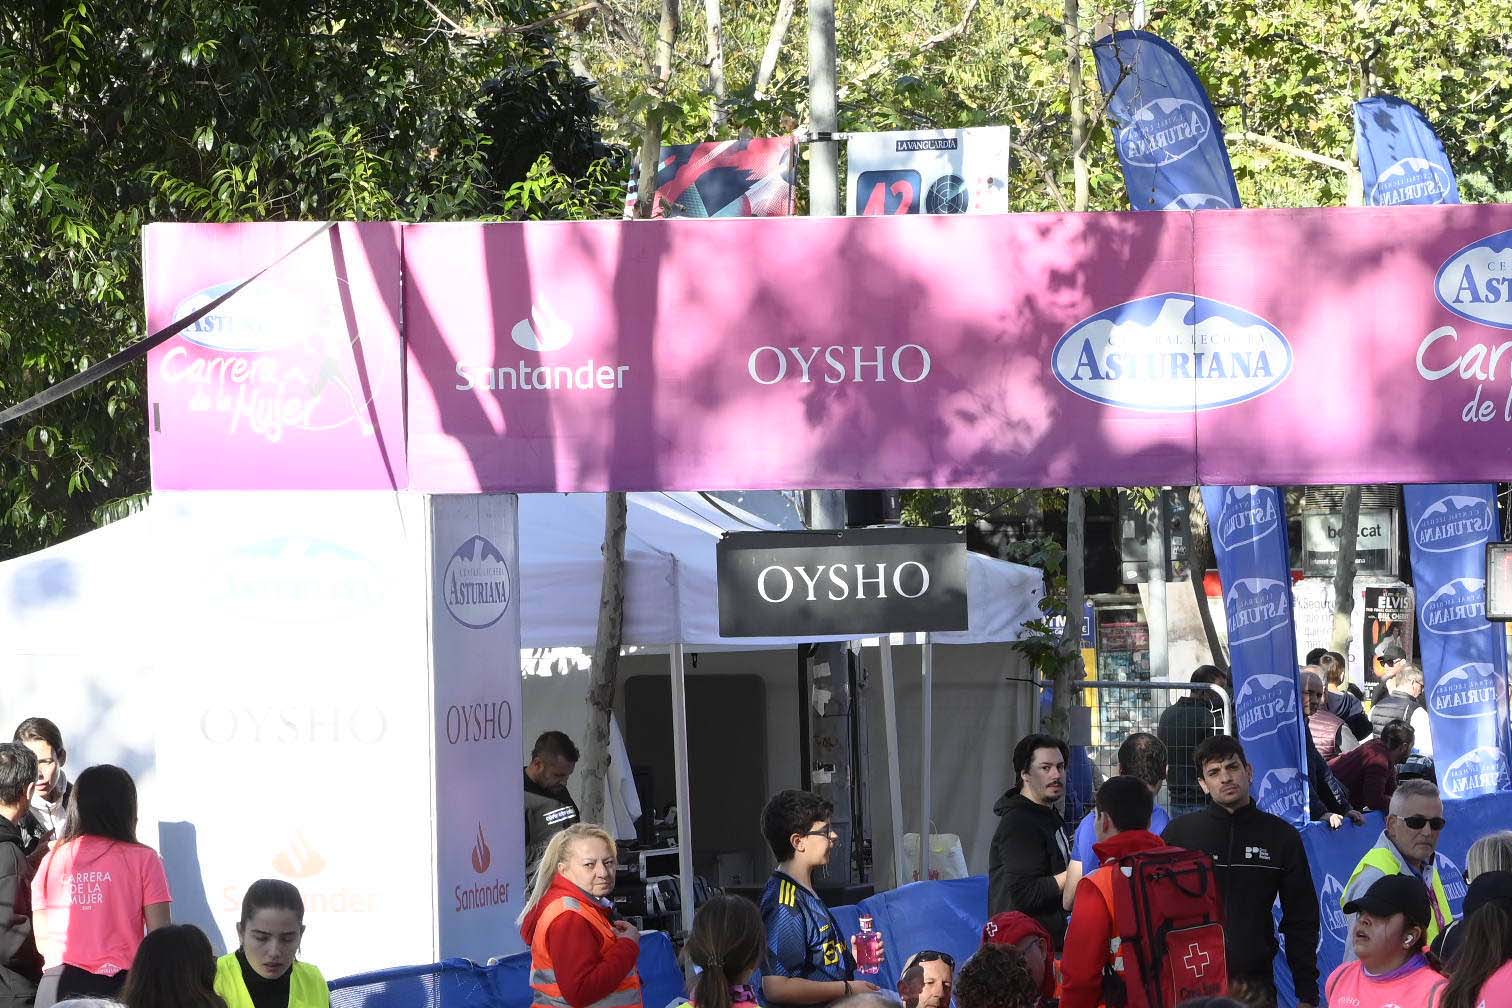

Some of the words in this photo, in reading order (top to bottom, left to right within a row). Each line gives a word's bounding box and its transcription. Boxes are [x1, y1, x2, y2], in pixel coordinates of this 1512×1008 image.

[908, 138, 957, 150] VANGUARDIA
[455, 359, 630, 391] Santander
[747, 343, 932, 385] OYSHO
[1071, 337, 1274, 382] ASTURIANA
[1462, 383, 1497, 423] de
[449, 569, 508, 606] ASTURIANA
[757, 561, 930, 604] OYSHO
[1378, 596, 1409, 609] ELVIS
[446, 700, 513, 746] OYSHO
[68, 894, 104, 904] MUJER
[70, 883, 84, 894] DE
[88, 884, 101, 893] LA
[456, 881, 510, 914] Santander
